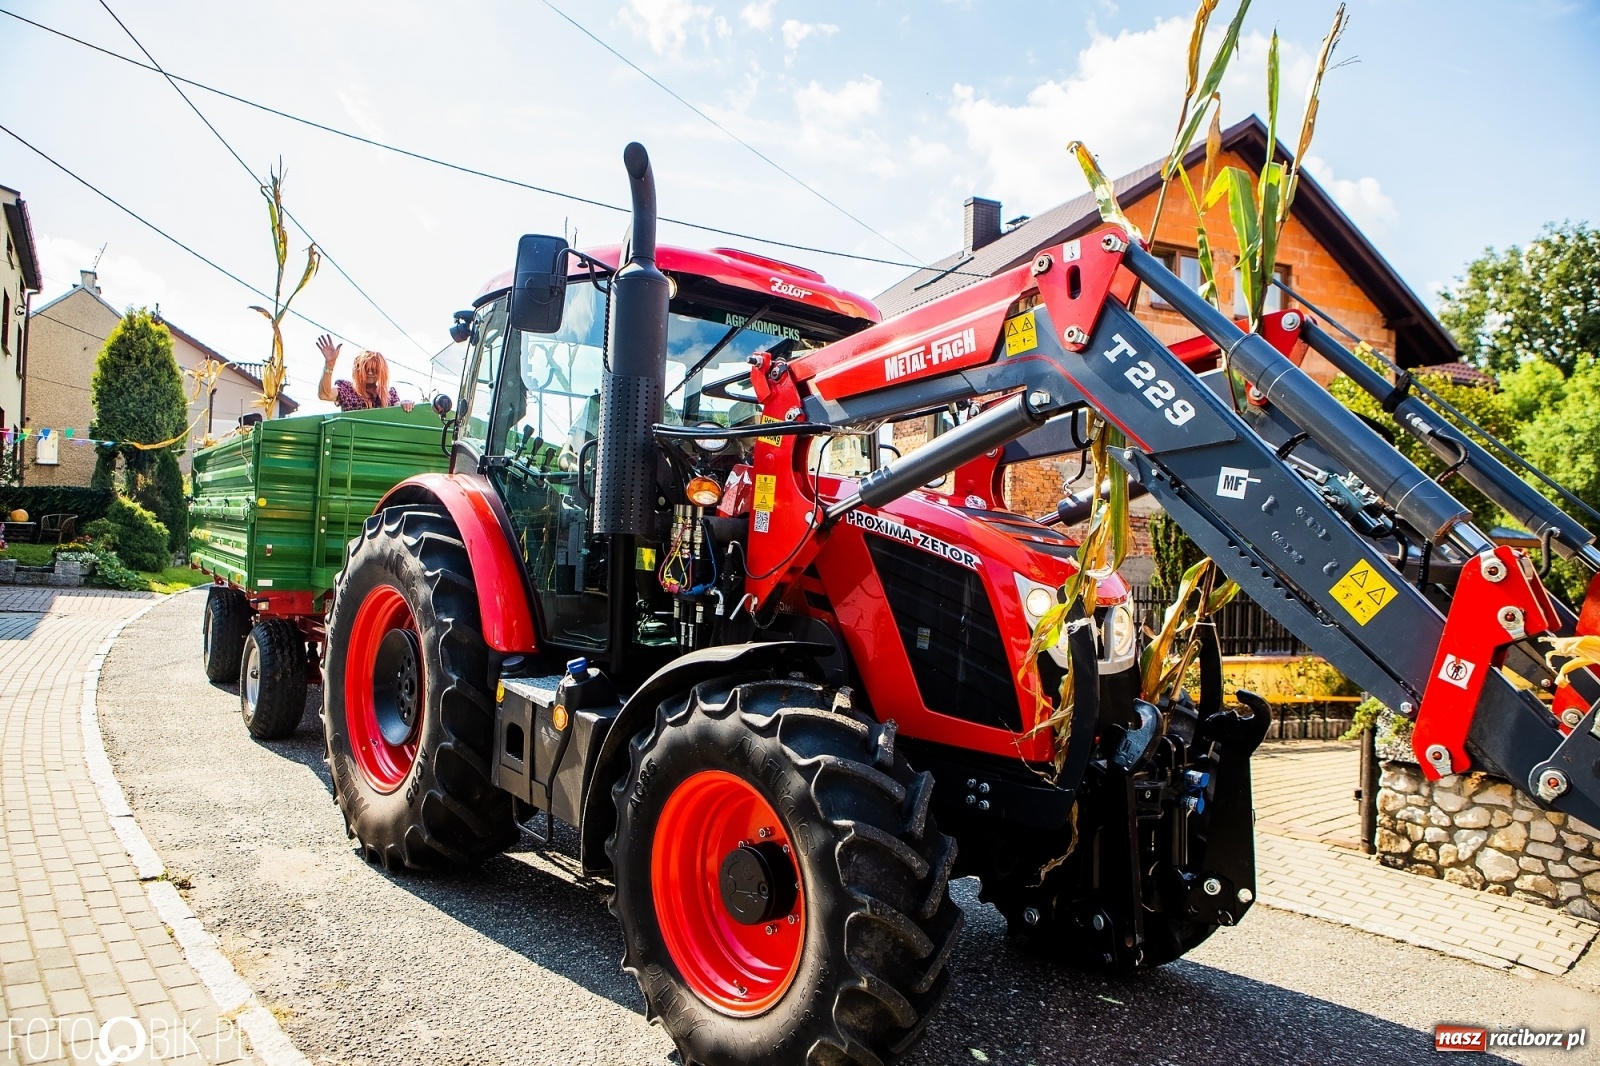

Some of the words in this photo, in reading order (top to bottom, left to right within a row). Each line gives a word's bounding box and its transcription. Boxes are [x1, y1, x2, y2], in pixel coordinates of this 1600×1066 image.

[769, 277, 812, 299] Zetor
[1103, 333, 1138, 364] T
[1124, 360, 1196, 426] 229
[1222, 474, 1247, 492] MF
[848, 511, 913, 543] PROXIMA
[919, 533, 975, 568] ZETOR
